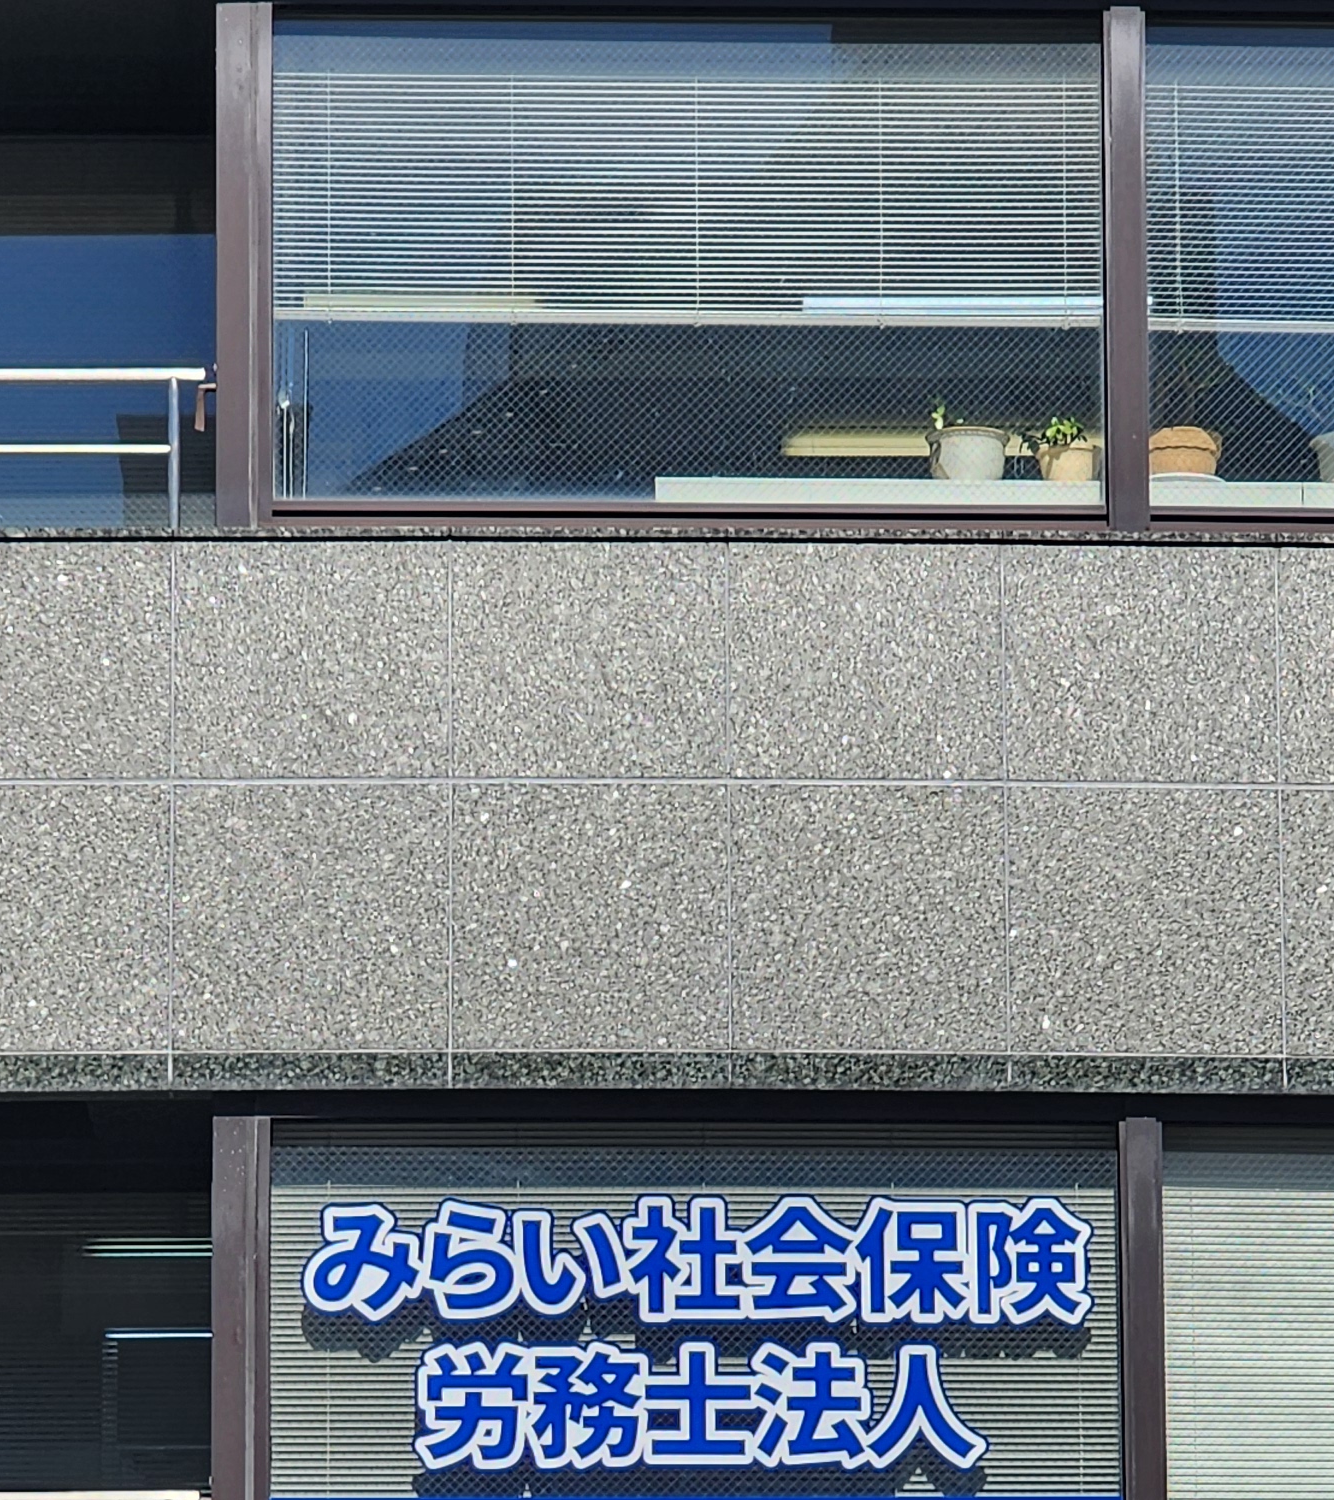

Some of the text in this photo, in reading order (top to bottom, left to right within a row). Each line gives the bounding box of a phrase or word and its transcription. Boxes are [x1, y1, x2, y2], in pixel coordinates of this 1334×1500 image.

[302, 1196, 1093, 1325] みらい社会保険
[413, 1341, 989, 1471] 労務士法人
